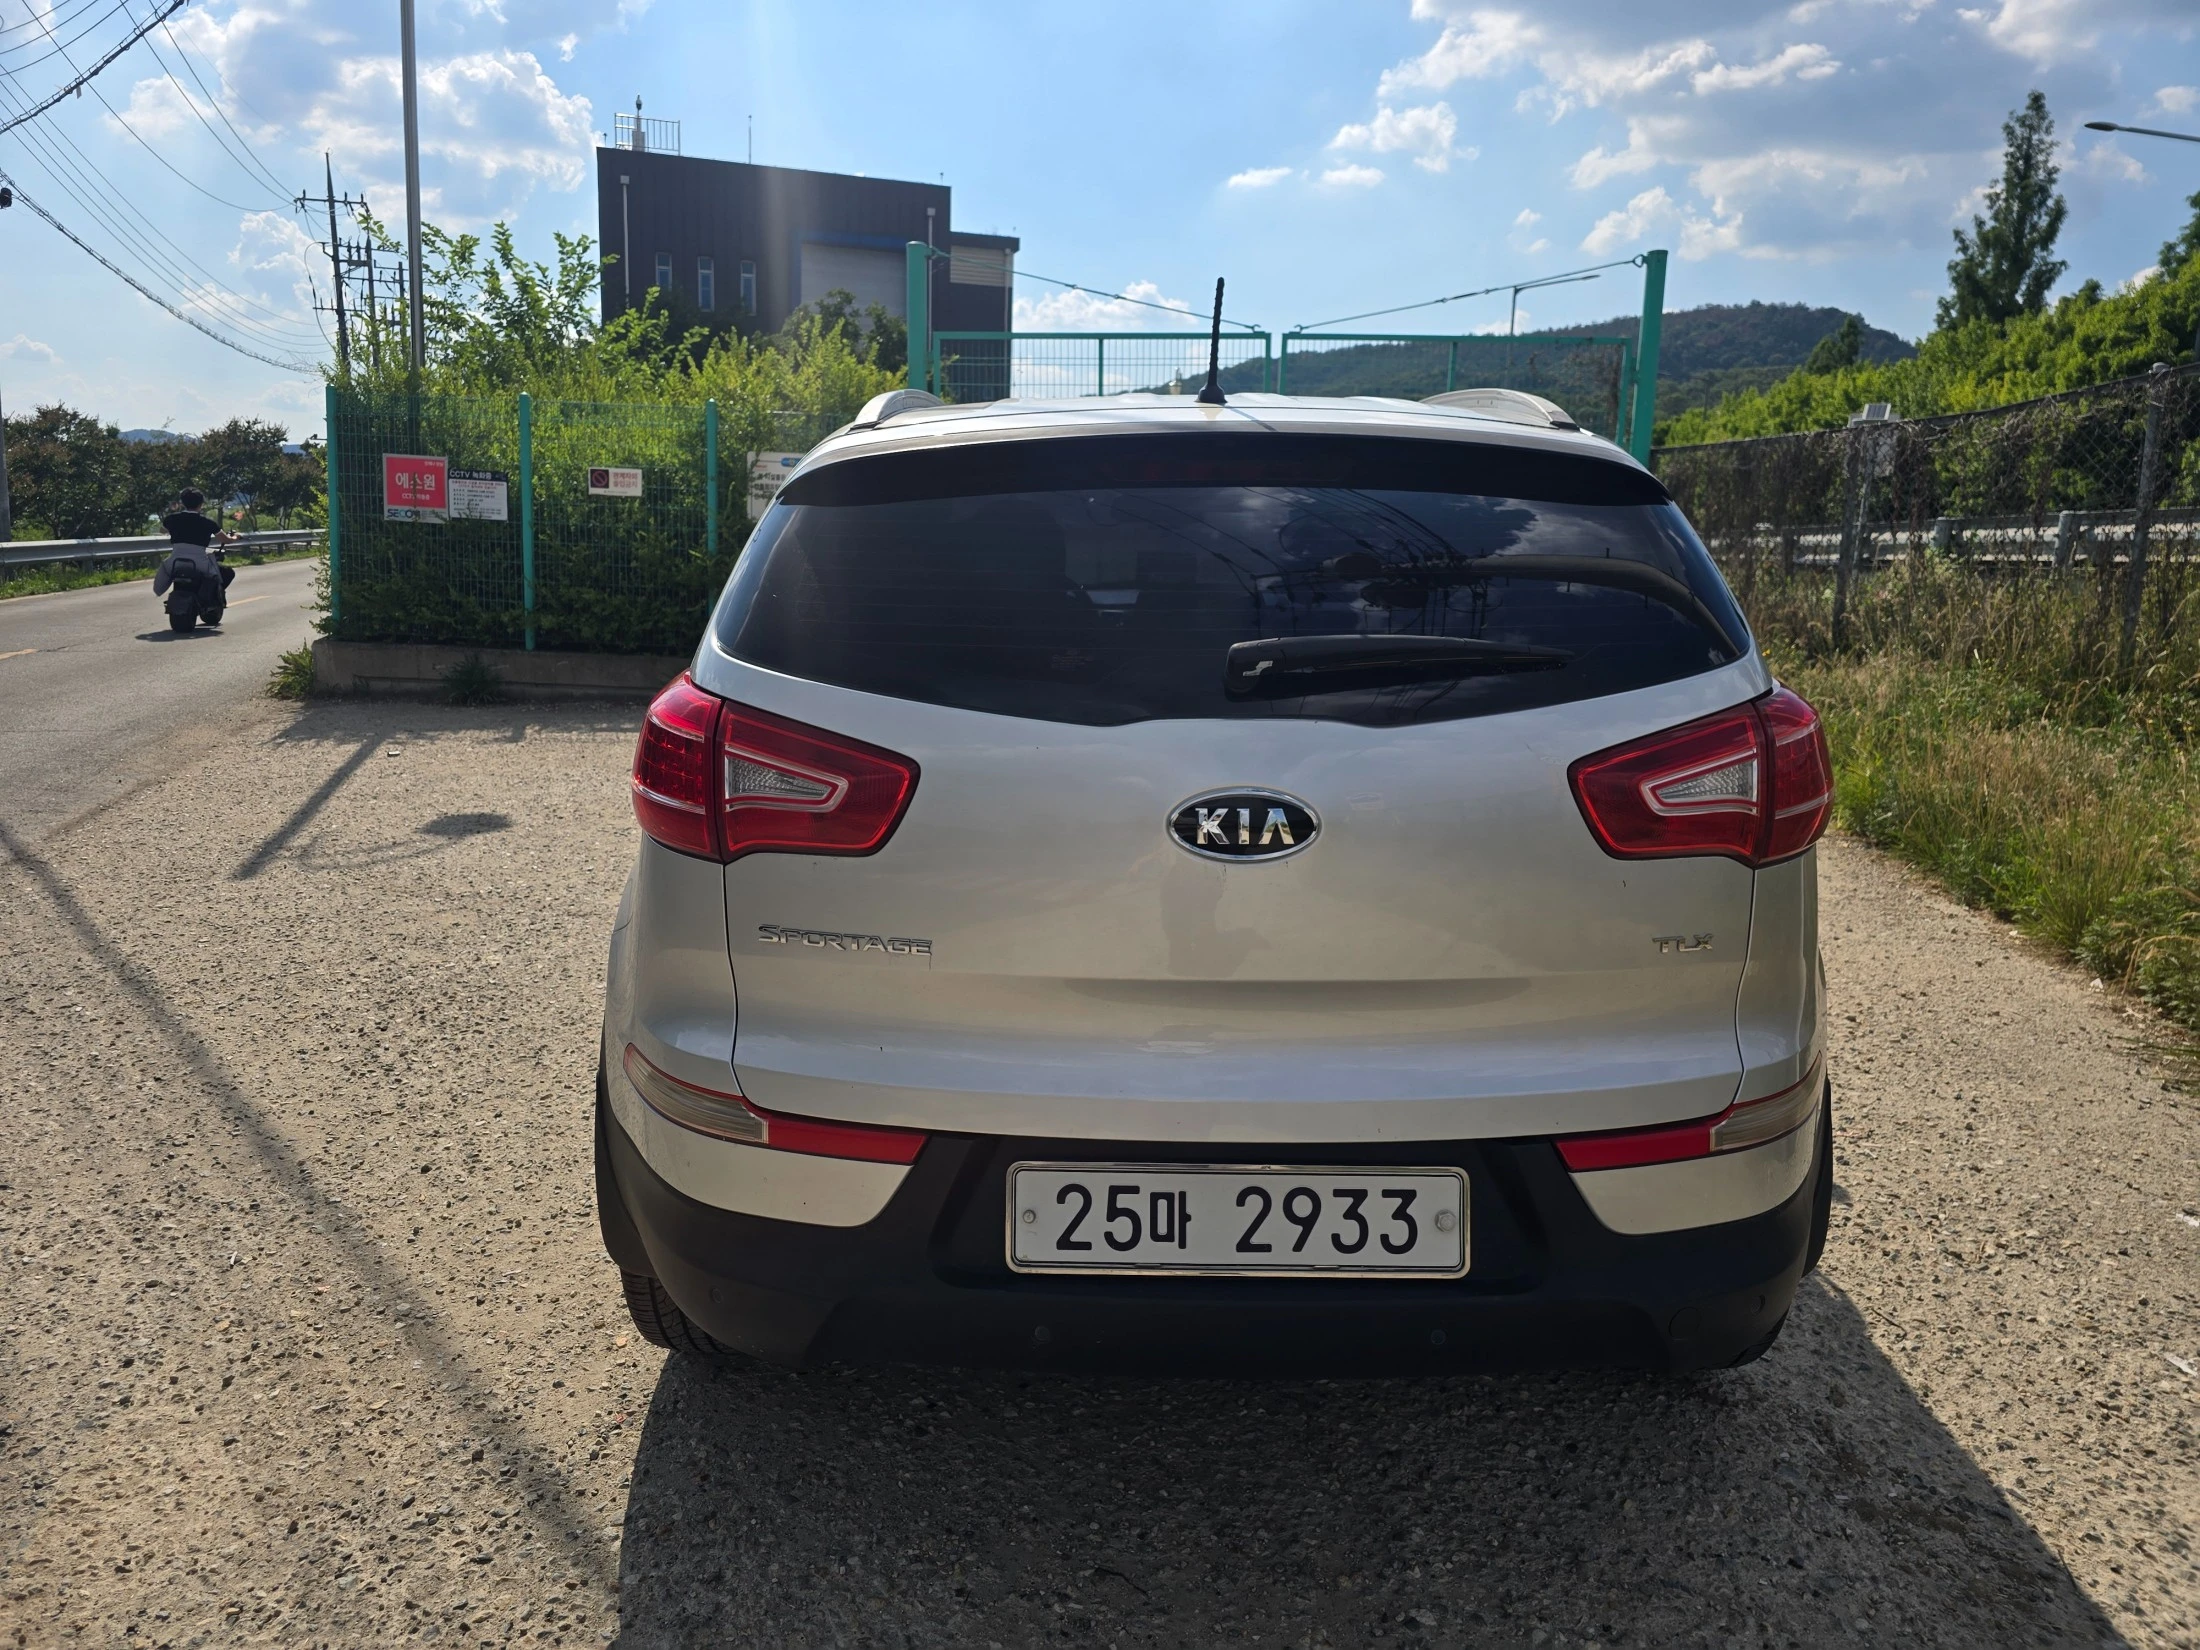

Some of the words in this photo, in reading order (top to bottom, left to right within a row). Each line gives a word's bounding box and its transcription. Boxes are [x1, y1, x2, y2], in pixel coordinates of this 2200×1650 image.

[395, 472, 435, 490] 에스원
[450, 470, 470, 478] CCTV
[1194, 807, 1296, 846] KIA
[757, 923, 933, 957] SPORTAGE
[1651, 932, 1714, 954] TLX
[1055, 1183, 1193, 1253] 25마
[1235, 1185, 1419, 1256] 2933
